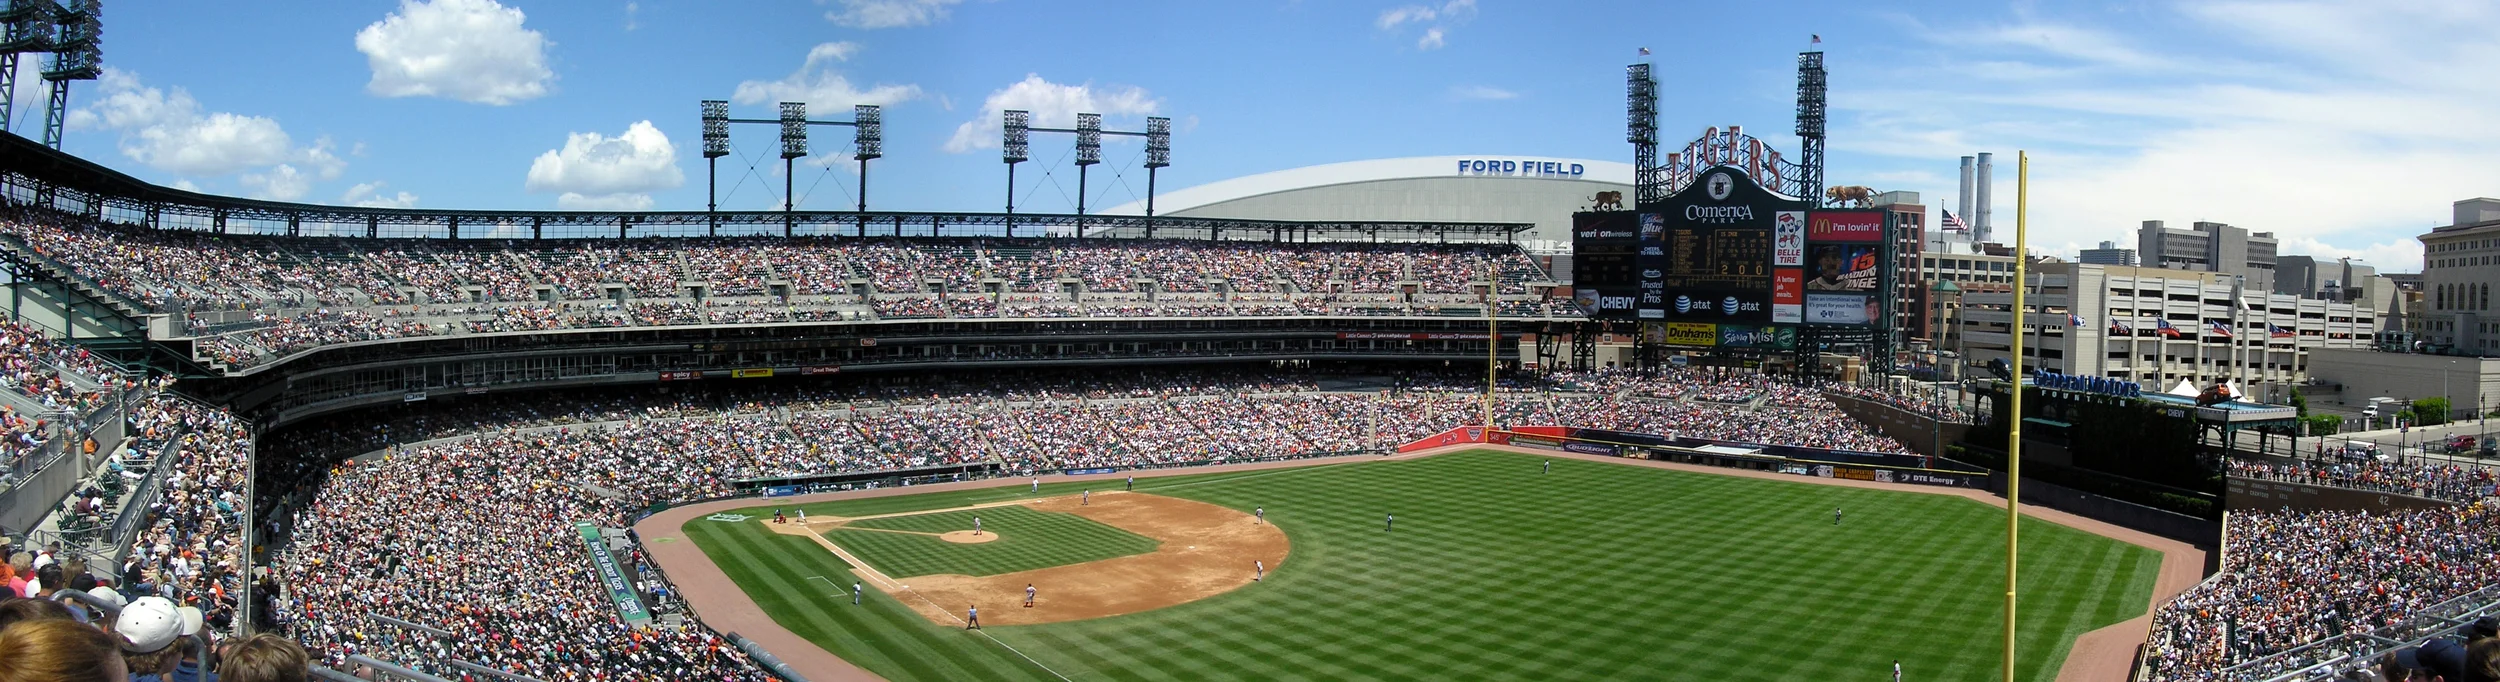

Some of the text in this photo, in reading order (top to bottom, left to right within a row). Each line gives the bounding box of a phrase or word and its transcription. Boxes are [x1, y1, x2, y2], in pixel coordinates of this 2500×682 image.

[1667, 125, 1782, 192] TIGERS
[1458, 160, 1584, 176] FORD FIELD
[1641, 223, 1663, 233] Blue
[1873, 223, 1879, 231] it
[1851, 252, 1876, 271] 15
[1722, 264, 1728, 275] 2
[1739, 264, 1746, 275] 0
[1756, 264, 1763, 276] 0
[1641, 280, 1664, 288] Trusted
[1846, 277, 1877, 289] INGE
[1601, 296, 1635, 309] CHEVY
[1643, 292, 1662, 303] Pros
[1693, 300, 1711, 310] at&t
[1740, 301, 1760, 311] at&t
[1669, 328, 1715, 339] Dunham's
[1724, 333, 1748, 345] Sierra
[1747, 331, 1774, 344] Mist
[2033, 369, 2141, 398] General Motors
[2042, 389, 2126, 407] FOUNTAIN
[2168, 409, 2185, 418] CHEVY
[1929, 476, 1955, 485] Energy
[2378, 495, 2389, 506] 42
